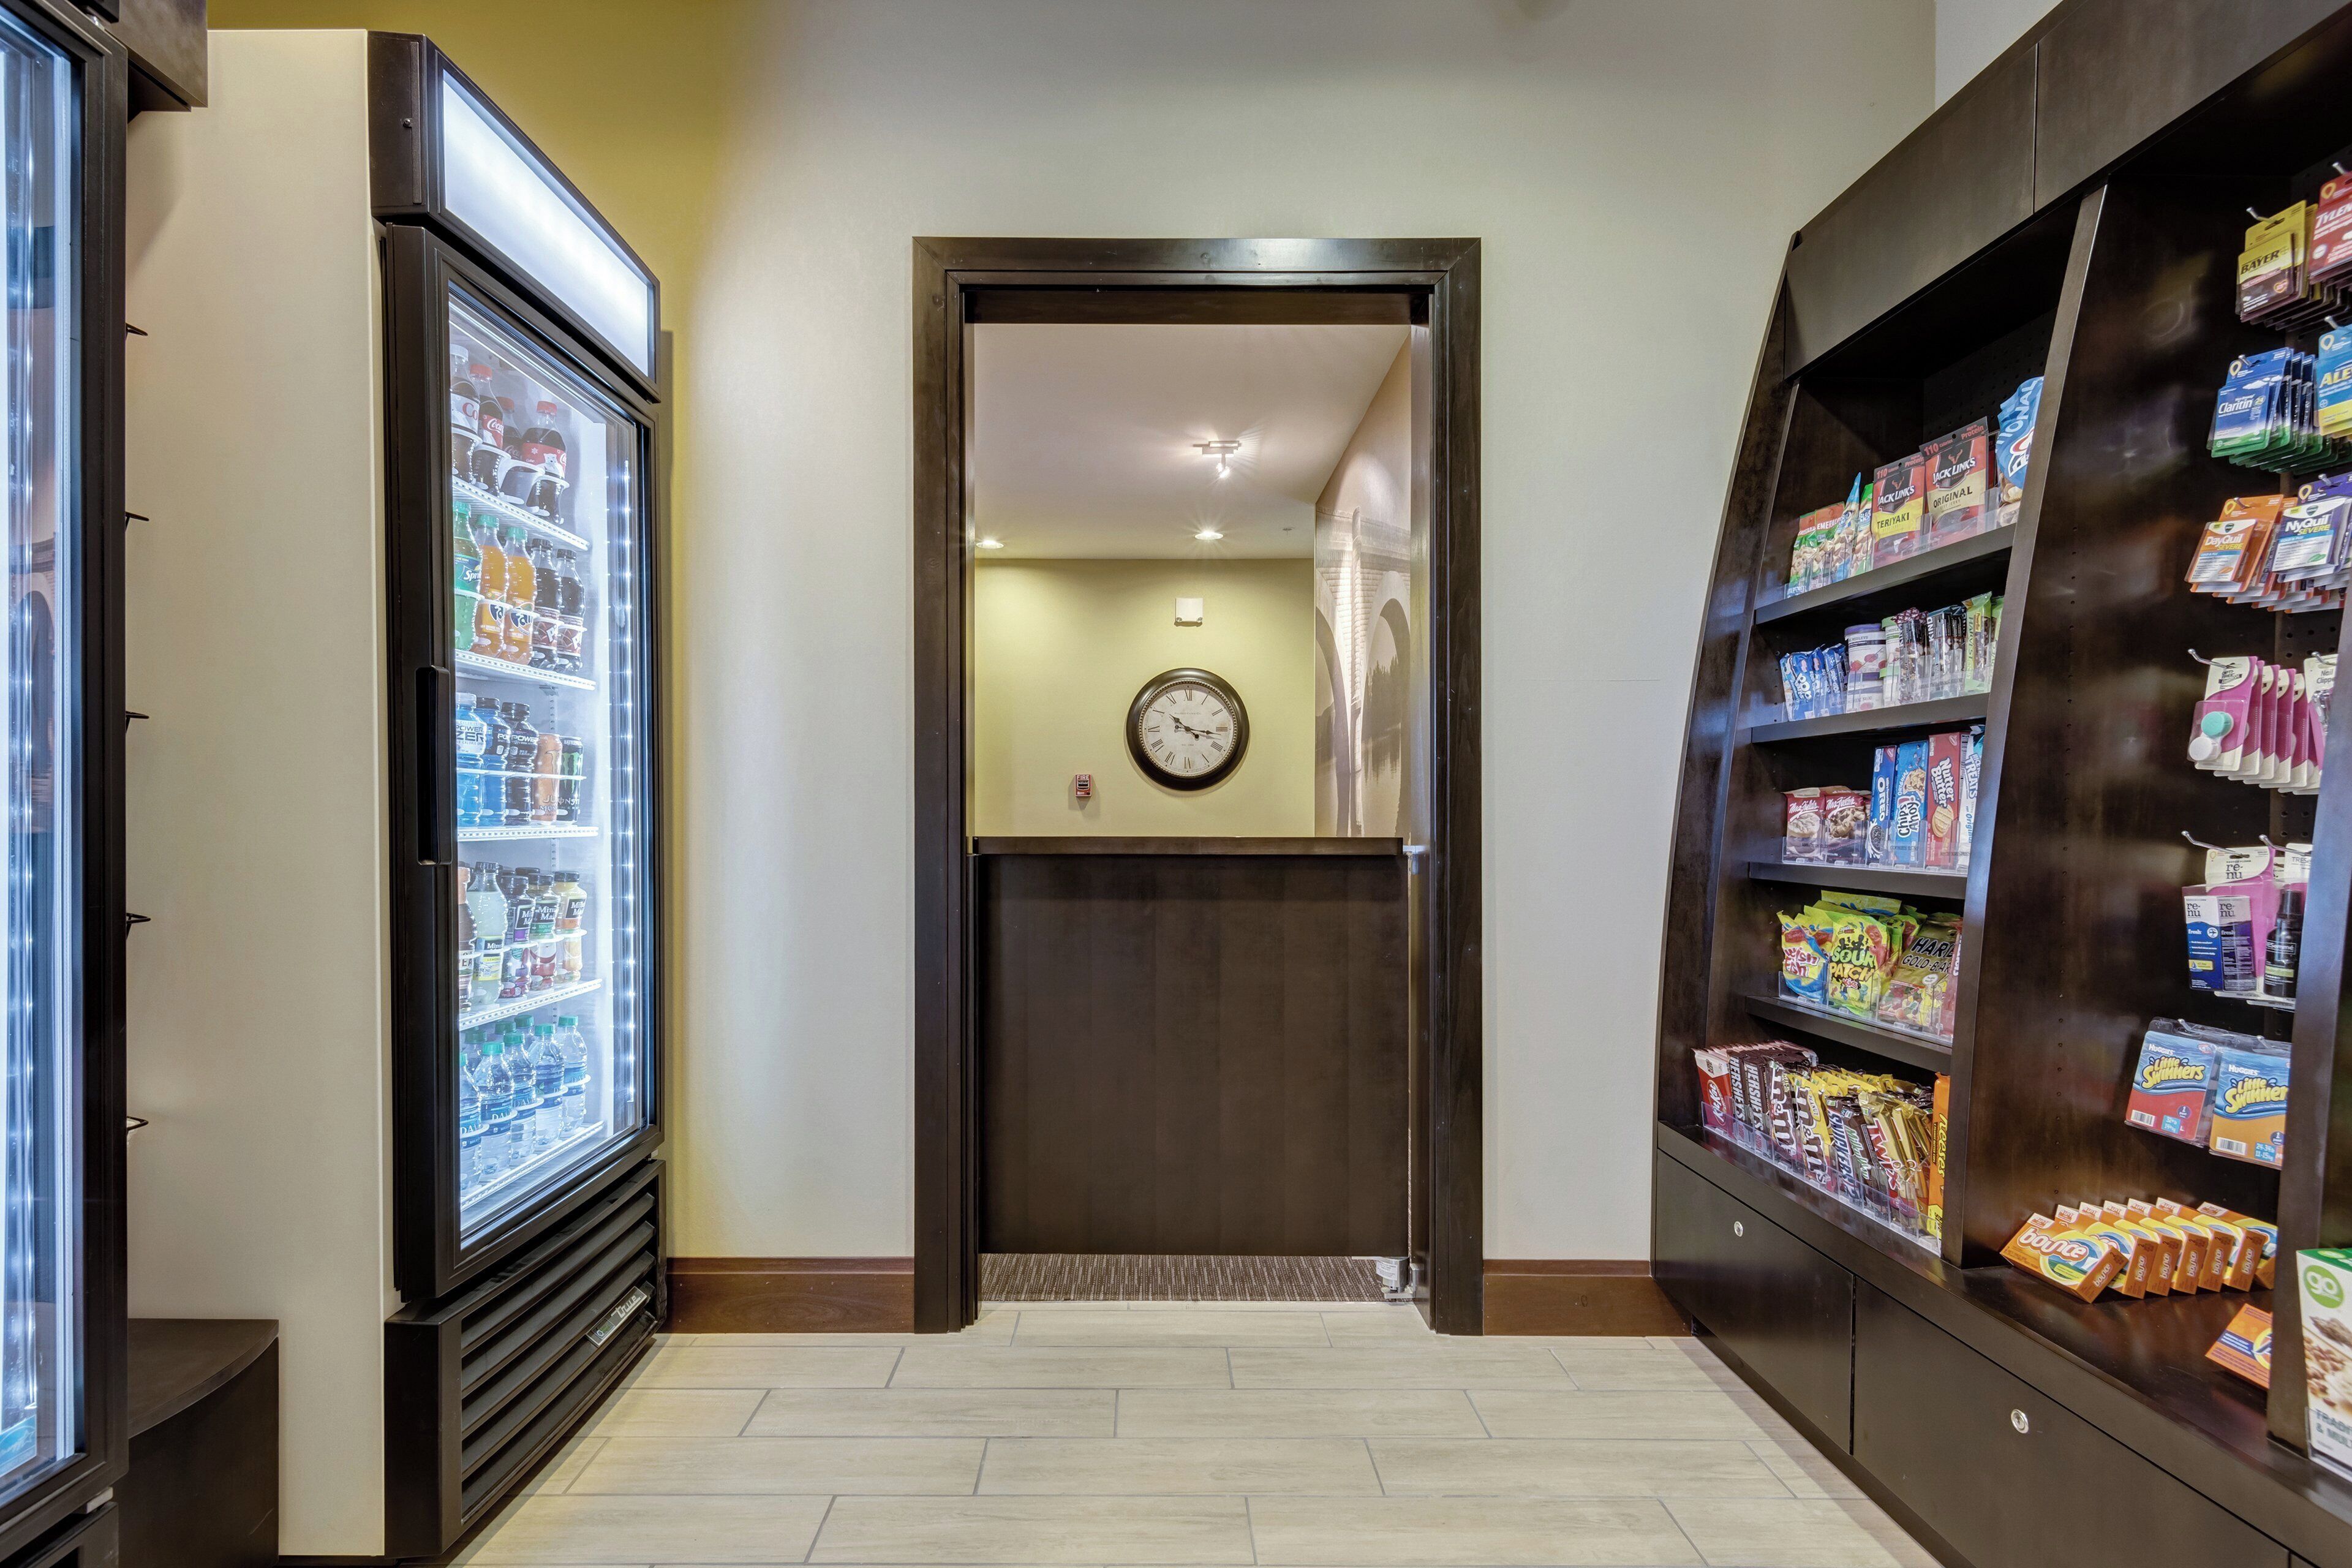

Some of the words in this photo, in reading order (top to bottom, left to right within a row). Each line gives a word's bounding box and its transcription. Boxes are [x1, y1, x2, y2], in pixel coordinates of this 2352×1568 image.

[2241, 250, 2280, 275] BAYER
[2218, 399, 2253, 415] Claritin
[1961, 425, 1984, 440] Protein
[1924, 442, 1939, 456] 110
[1877, 468, 1888, 480] 110
[1932, 469, 1952, 484] JACK
[1951, 457, 1976, 476] LINK'S
[1878, 493, 1894, 507] JACK
[1894, 485, 1915, 503] LINK'S
[1933, 486, 1973, 508] ORIGINAL
[1877, 512, 1910, 530] TERIYAKI
[2285, 514, 2332, 532] NyQuil
[2298, 525, 2331, 535] SEVERE
[2205, 533, 2244, 547] DayQuil
[1898, 770, 1909, 796] ORIGINAL
[1931, 764, 1948, 809] Butter
[1940, 757, 1955, 802] Nutter
[1964, 757, 1978, 799] TREATS
[1877, 775, 1886, 822] OREO
[1898, 804, 1912, 837] Chips
[1832, 946, 1876, 967] SOUR
[1829, 962, 1875, 982] PATCH
[2154, 1056, 2180, 1071] Little
[1730, 1057, 1745, 1121] HERSHEY'S
[2142, 1065, 2205, 1089] Swimmers
[2237, 1077, 2267, 1093] Little
[1746, 1063, 1764, 1131] HERSHEY'S
[1808, 1095, 1819, 1116] PEANUT
[1828, 1111, 1855, 1182] SNICKERS
[2018, 1226, 2090, 1260] bounce
[2135, 1254, 2147, 1281] bounce
[2159, 1252, 2172, 1279] bounce
[2187, 1251, 2199, 1277] bounce
[2212, 1248, 2224, 1275] bounce
[2242, 1247, 2255, 1275] bounce
[2093, 1263, 2111, 1288] bounce
[2306, 1271, 2339, 1295] go
